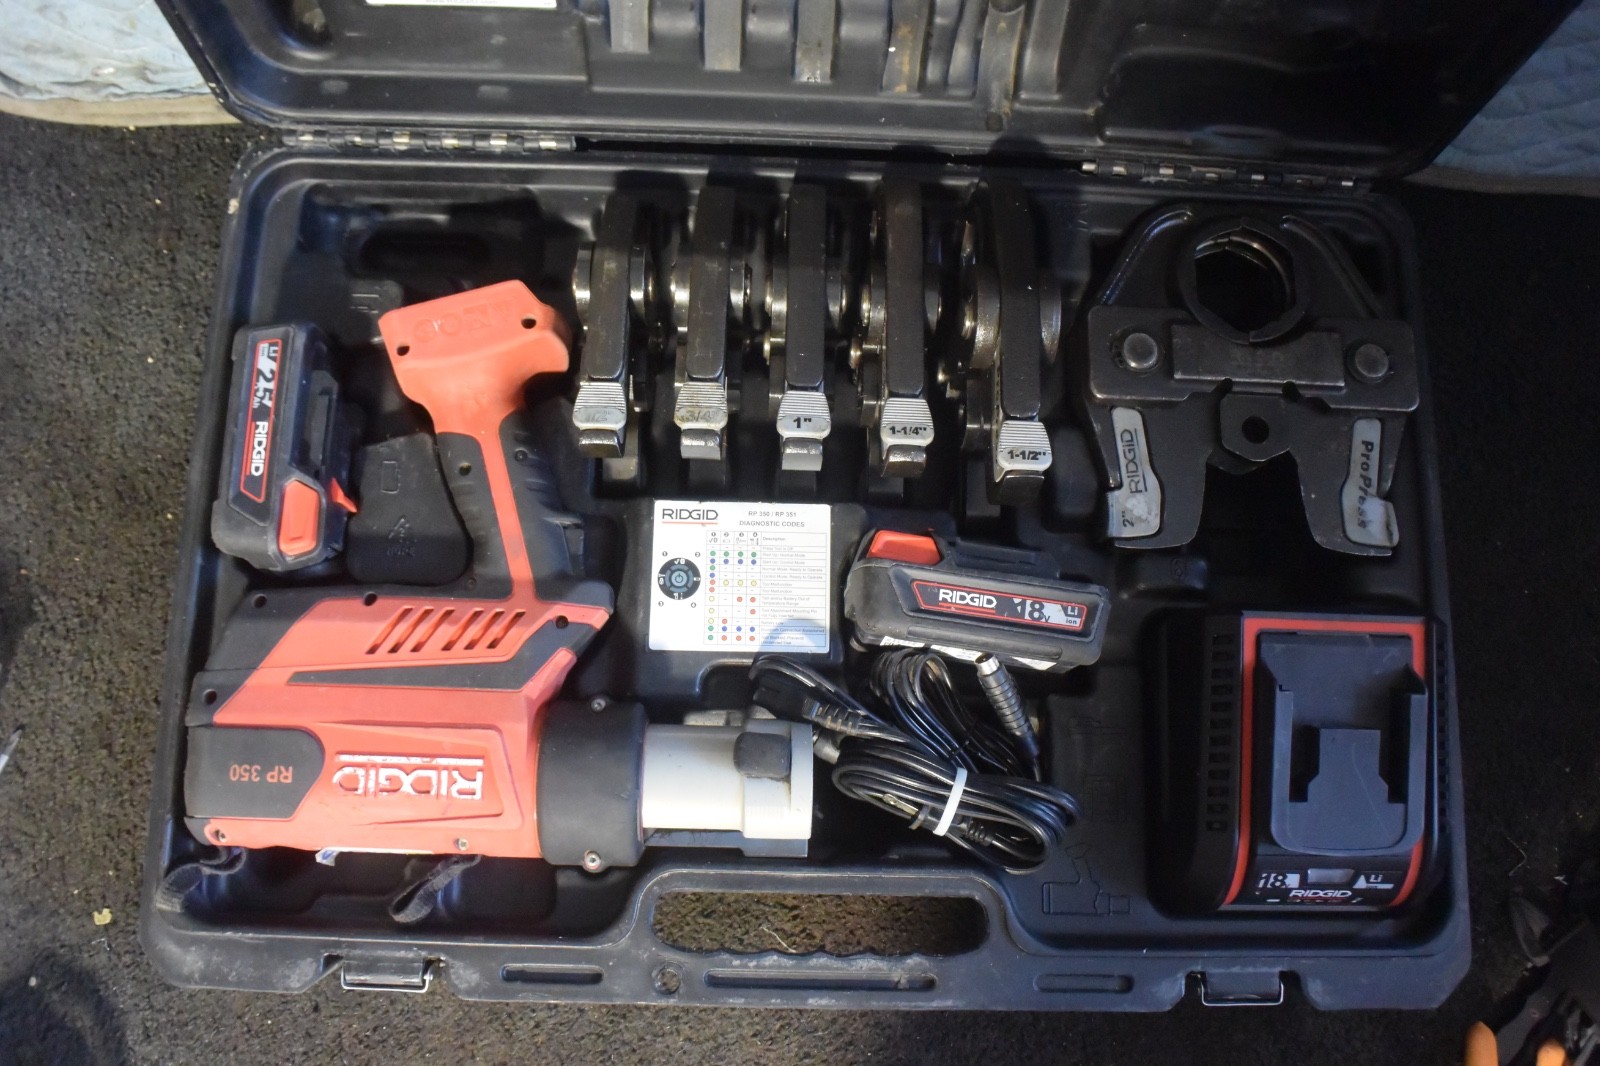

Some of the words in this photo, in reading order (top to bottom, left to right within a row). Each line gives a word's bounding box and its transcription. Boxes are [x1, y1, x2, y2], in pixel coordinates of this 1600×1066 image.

[793, 417, 812, 429] 1"
[889, 426, 927, 436] 1-1/4"
[250, 421, 269, 477] RIDGID
[1008, 450, 1046, 461] 1-1/2"
[1120, 428, 1142, 494] RIDGID
[662, 508, 719, 520] RIDGID
[1122, 510, 1134, 528] 2"
[938, 588, 997, 609] RIDGID
[1067, 606, 1079, 616] Li
[229, 763, 261, 782] 350
[266, 765, 293, 784] RP
[332, 766, 483, 800] RIDGID
[1289, 889, 1352, 898] RIDGID
